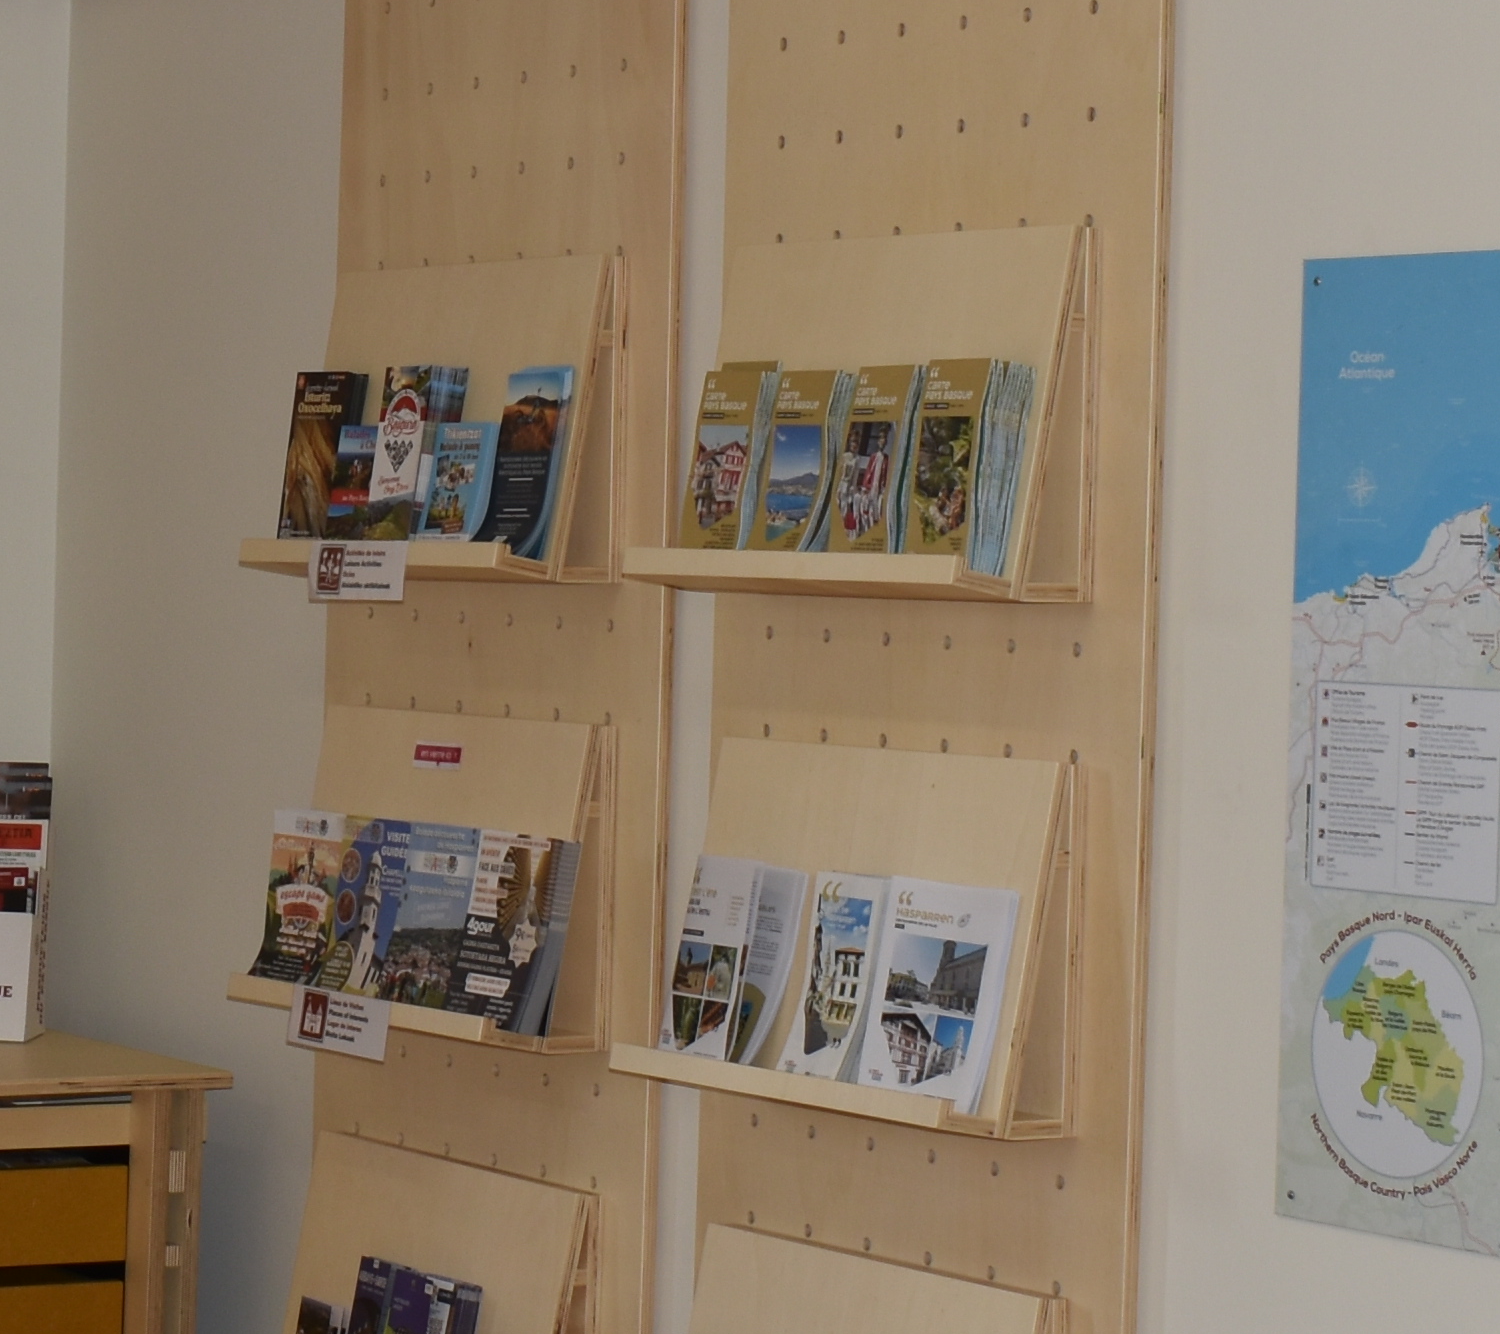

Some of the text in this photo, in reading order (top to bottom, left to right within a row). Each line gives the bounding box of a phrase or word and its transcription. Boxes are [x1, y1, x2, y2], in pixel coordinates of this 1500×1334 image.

[1339, 367, 1395, 380] Atlantique
[1351, 351, 1384, 363] Océan
[1320, 911, 1477, 981] Pays Basque Nord Ipar Euskal Herria
[1310, 1113, 1339, 1163] Northern
[1338, 1157, 1368, 1189] Basque
[1370, 1182, 1405, 1200] Country
[1433, 1168, 1458, 1189] Vasco
[1456, 1140, 1478, 1169] Norte
